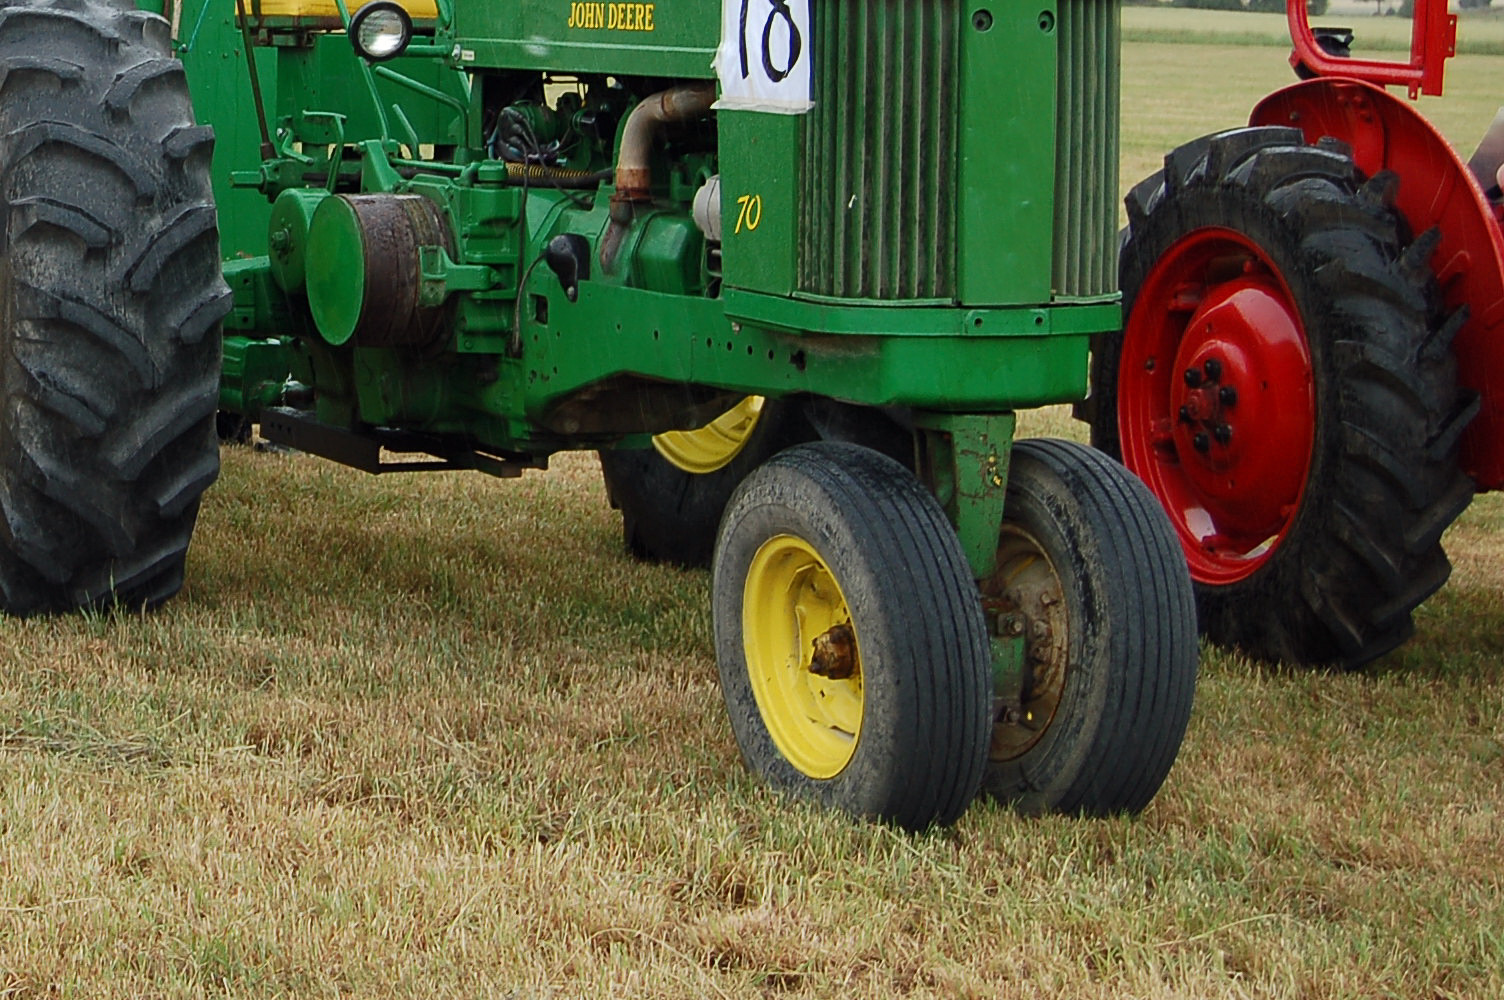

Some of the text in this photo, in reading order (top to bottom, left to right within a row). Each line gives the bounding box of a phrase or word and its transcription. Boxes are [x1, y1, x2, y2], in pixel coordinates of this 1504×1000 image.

[568, 2, 654, 31] JOHN DEERE
[734, 194, 761, 235] 70
